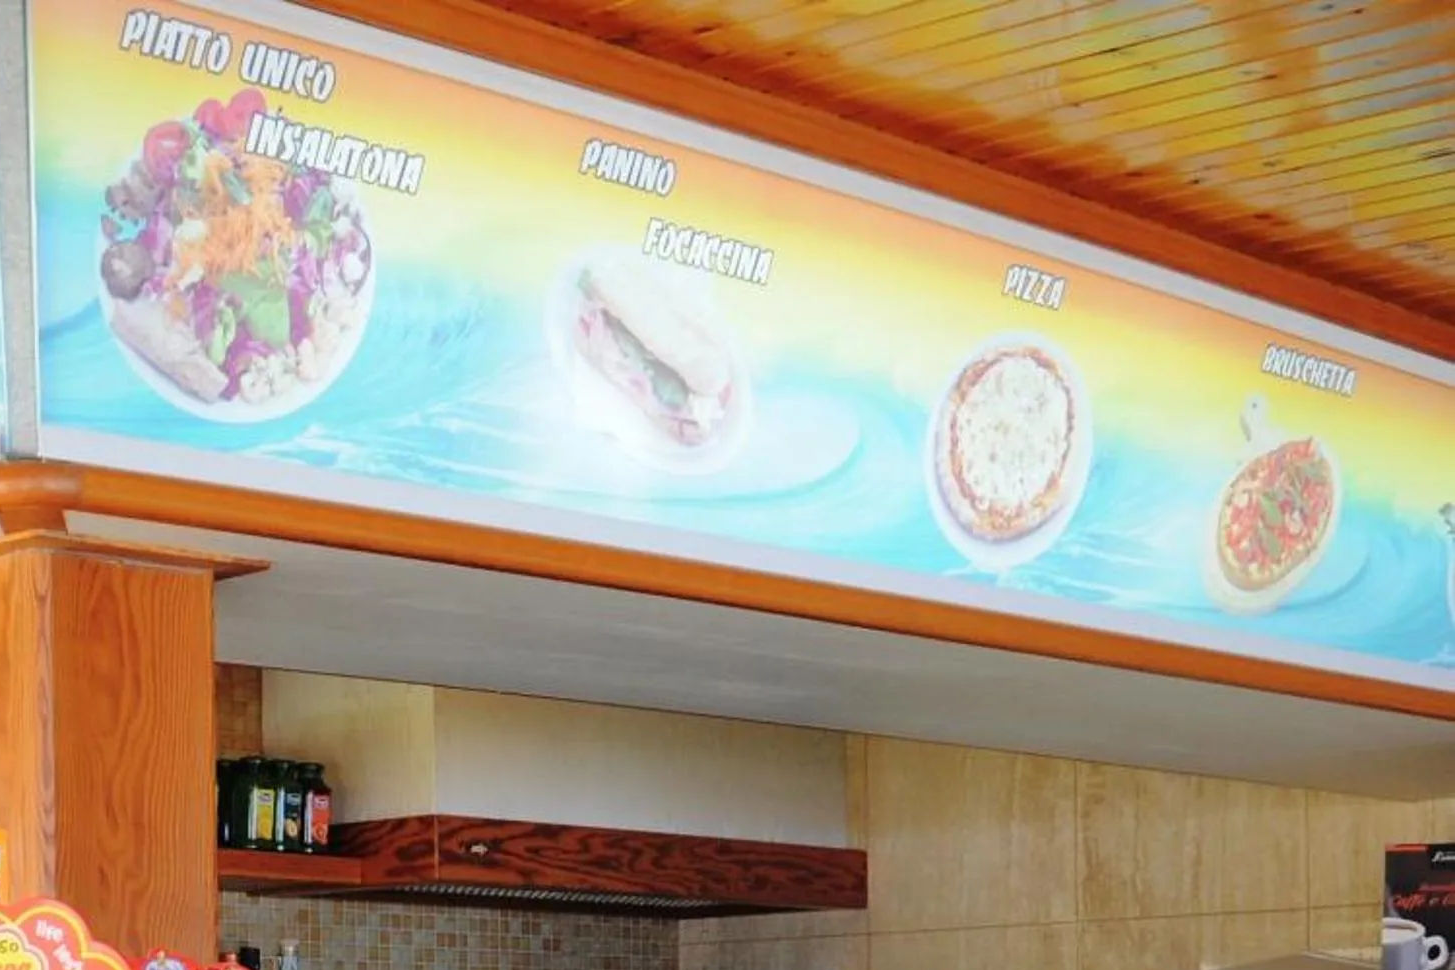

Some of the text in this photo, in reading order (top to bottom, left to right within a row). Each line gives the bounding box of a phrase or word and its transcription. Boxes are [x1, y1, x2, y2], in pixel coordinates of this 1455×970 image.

[120, 10, 336, 103] PIATTO UNICO
[244, 112, 425, 196] INSALATONA
[579, 137, 678, 197] PANINO
[644, 217, 775, 286] FOCACCINA
[1002, 263, 1068, 312] PIZZA
[1261, 342, 1357, 397] BRUSCHETTA
